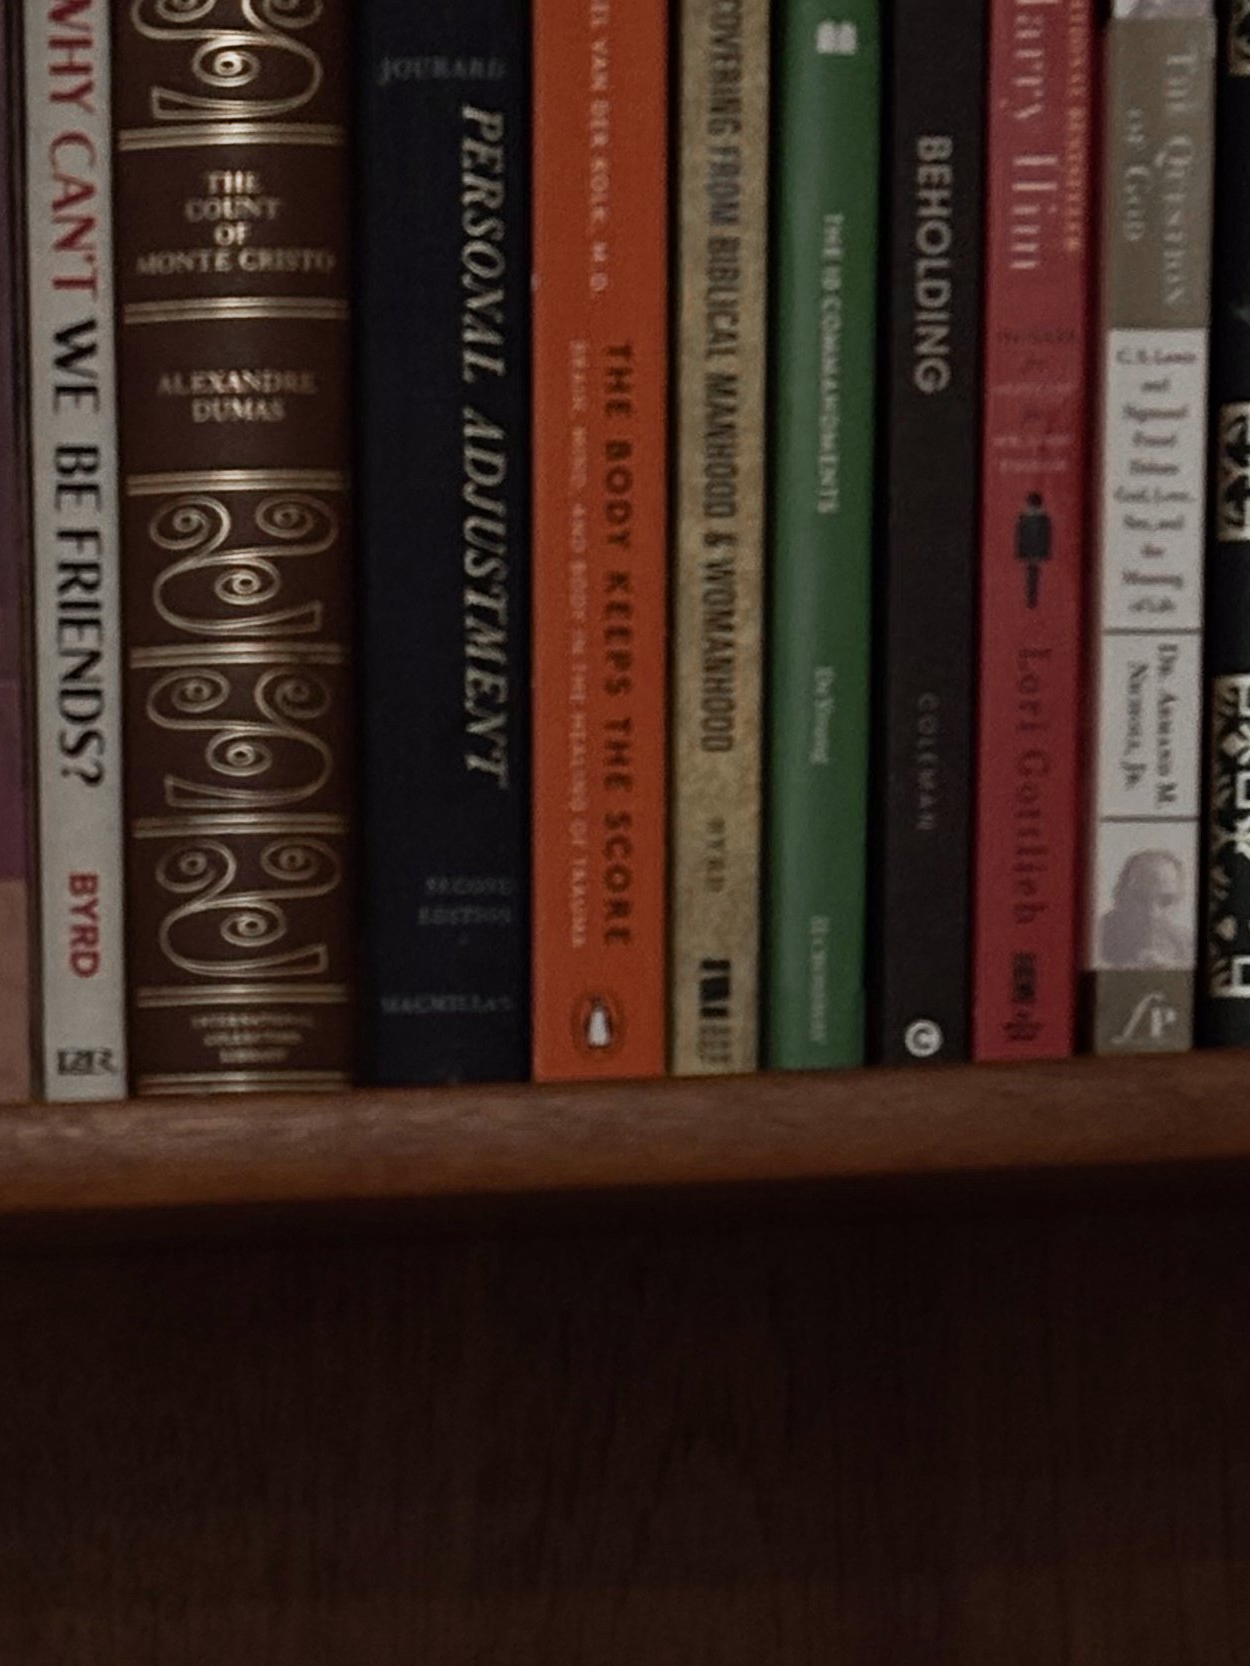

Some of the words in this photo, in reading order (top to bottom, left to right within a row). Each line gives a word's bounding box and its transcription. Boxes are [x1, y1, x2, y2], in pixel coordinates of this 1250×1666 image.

[49, 129, 101, 302] CAN'T
[459, 101, 508, 385] PERSONAL
[706, 145, 742, 226] FROM
[704, 236, 741, 361] BIBLICAL
[912, 134, 953, 394] BEHOLDING
[52, 315, 103, 415] WE
[604, 341, 638, 420] THE
[816, 294, 843, 515] COMMANDMENTS
[52, 443, 103, 516] BE
[603, 439, 637, 552] BODY
[703, 371, 739, 519] MANHOOD
[460, 404, 512, 792] ADJUSTMENT
[702, 530, 738, 554] &
[52, 526, 107, 789] FRIENDS?
[603, 570, 637, 699] KEEPS
[700, 559, 738, 753] WOMANHOOD
[1013, 645, 1053, 732] Lori
[603, 716, 636, 793] THE
[602, 811, 636, 950] SCORE
[1012, 748, 1052, 926] Gottlieb
[67, 870, 103, 981] BYRD
